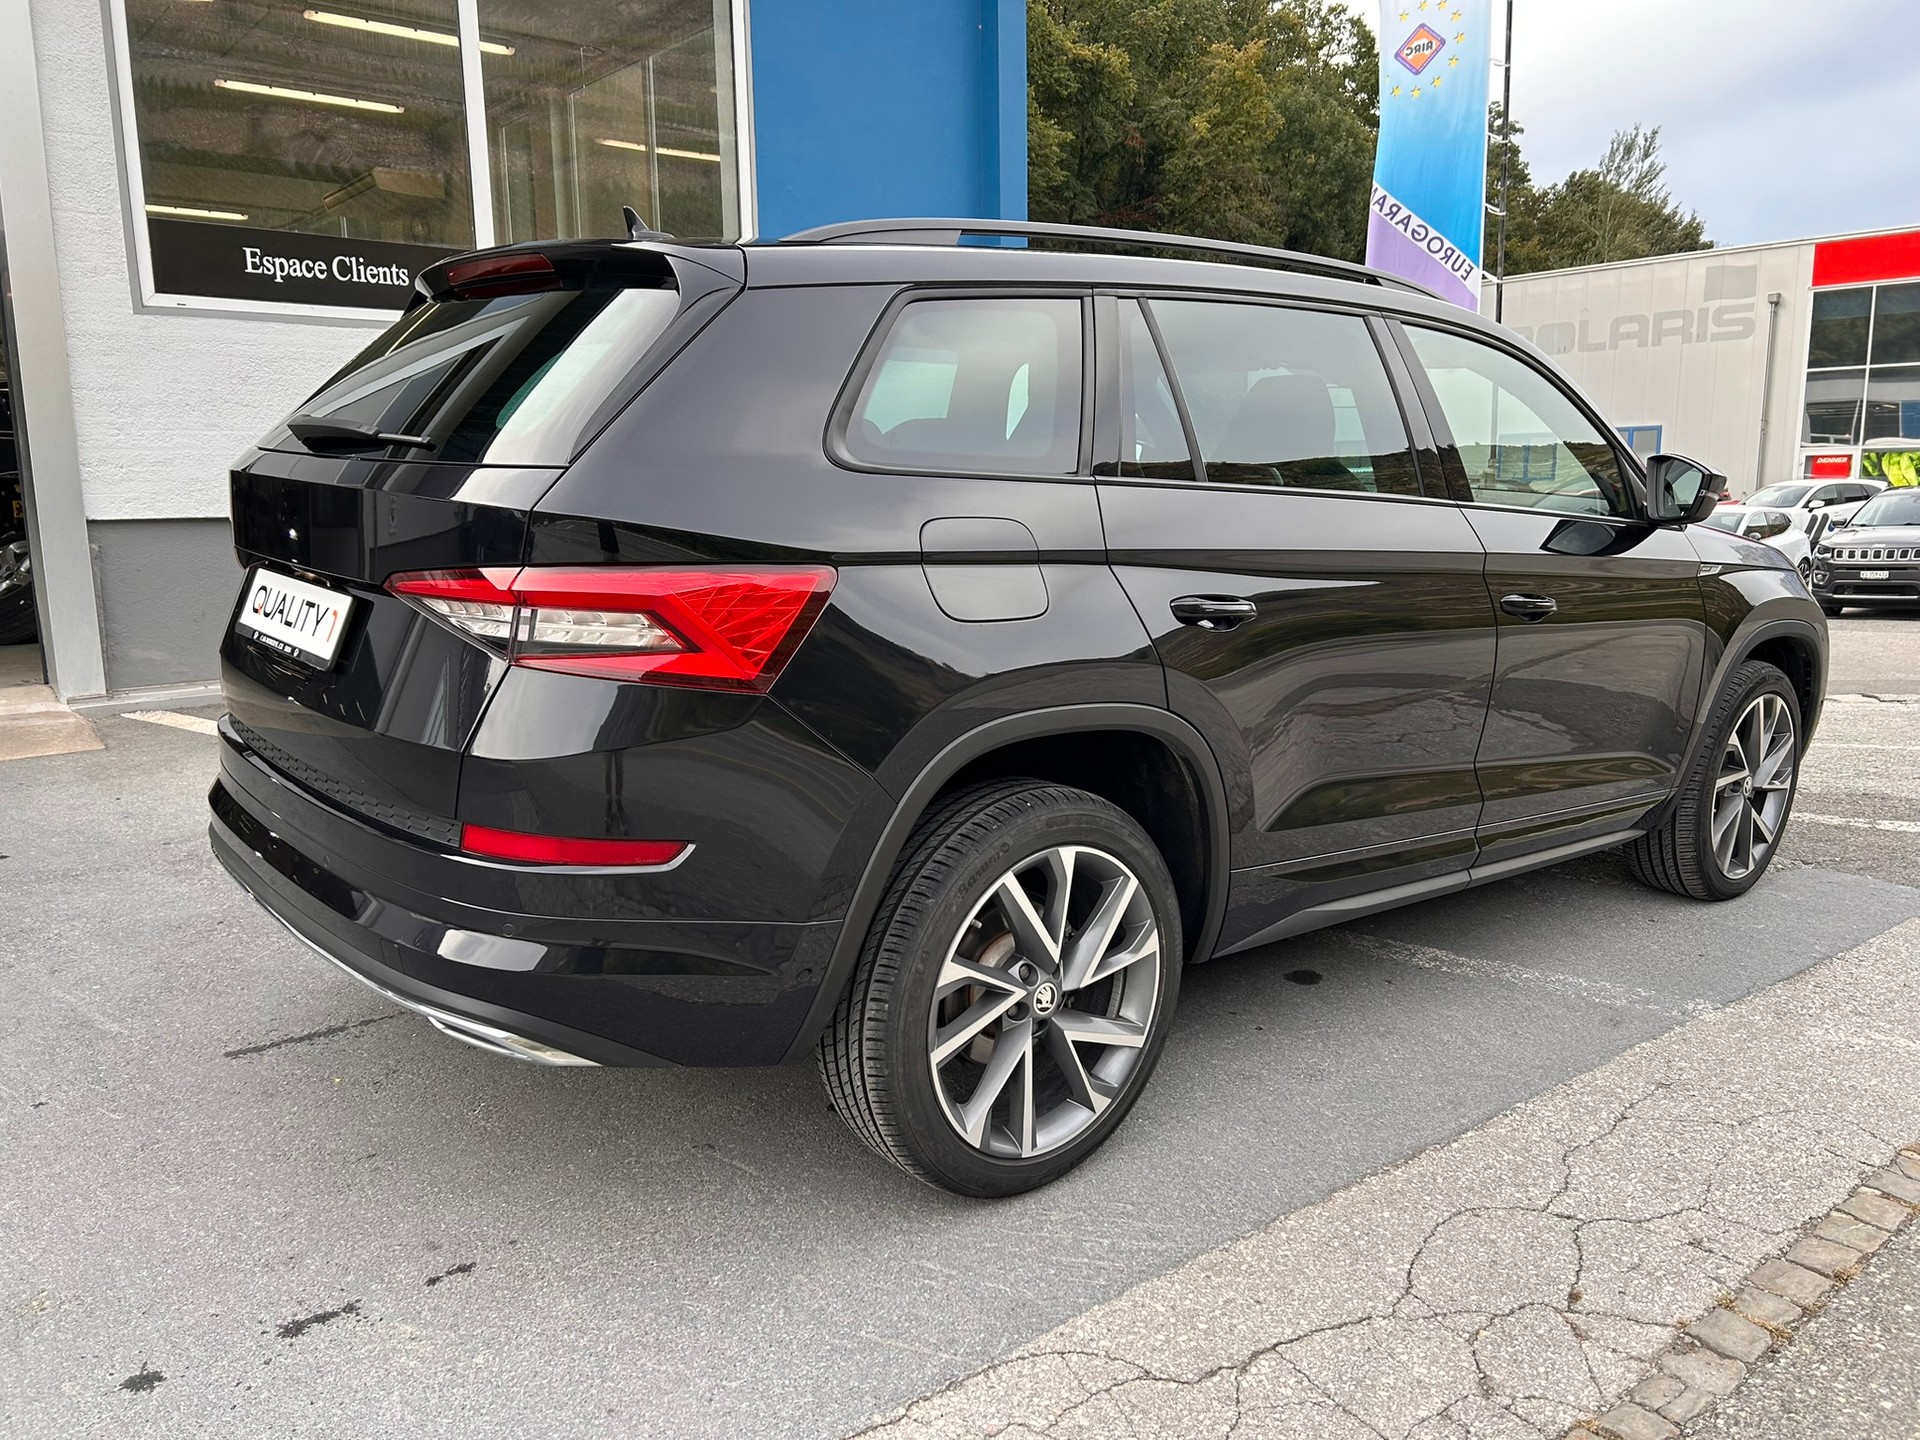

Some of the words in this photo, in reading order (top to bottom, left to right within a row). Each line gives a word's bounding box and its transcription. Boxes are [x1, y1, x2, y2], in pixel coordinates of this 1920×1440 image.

[242, 247, 327, 282] Espace
[332, 255, 409, 286] Clients
[1816, 456, 1848, 464] DENNER
